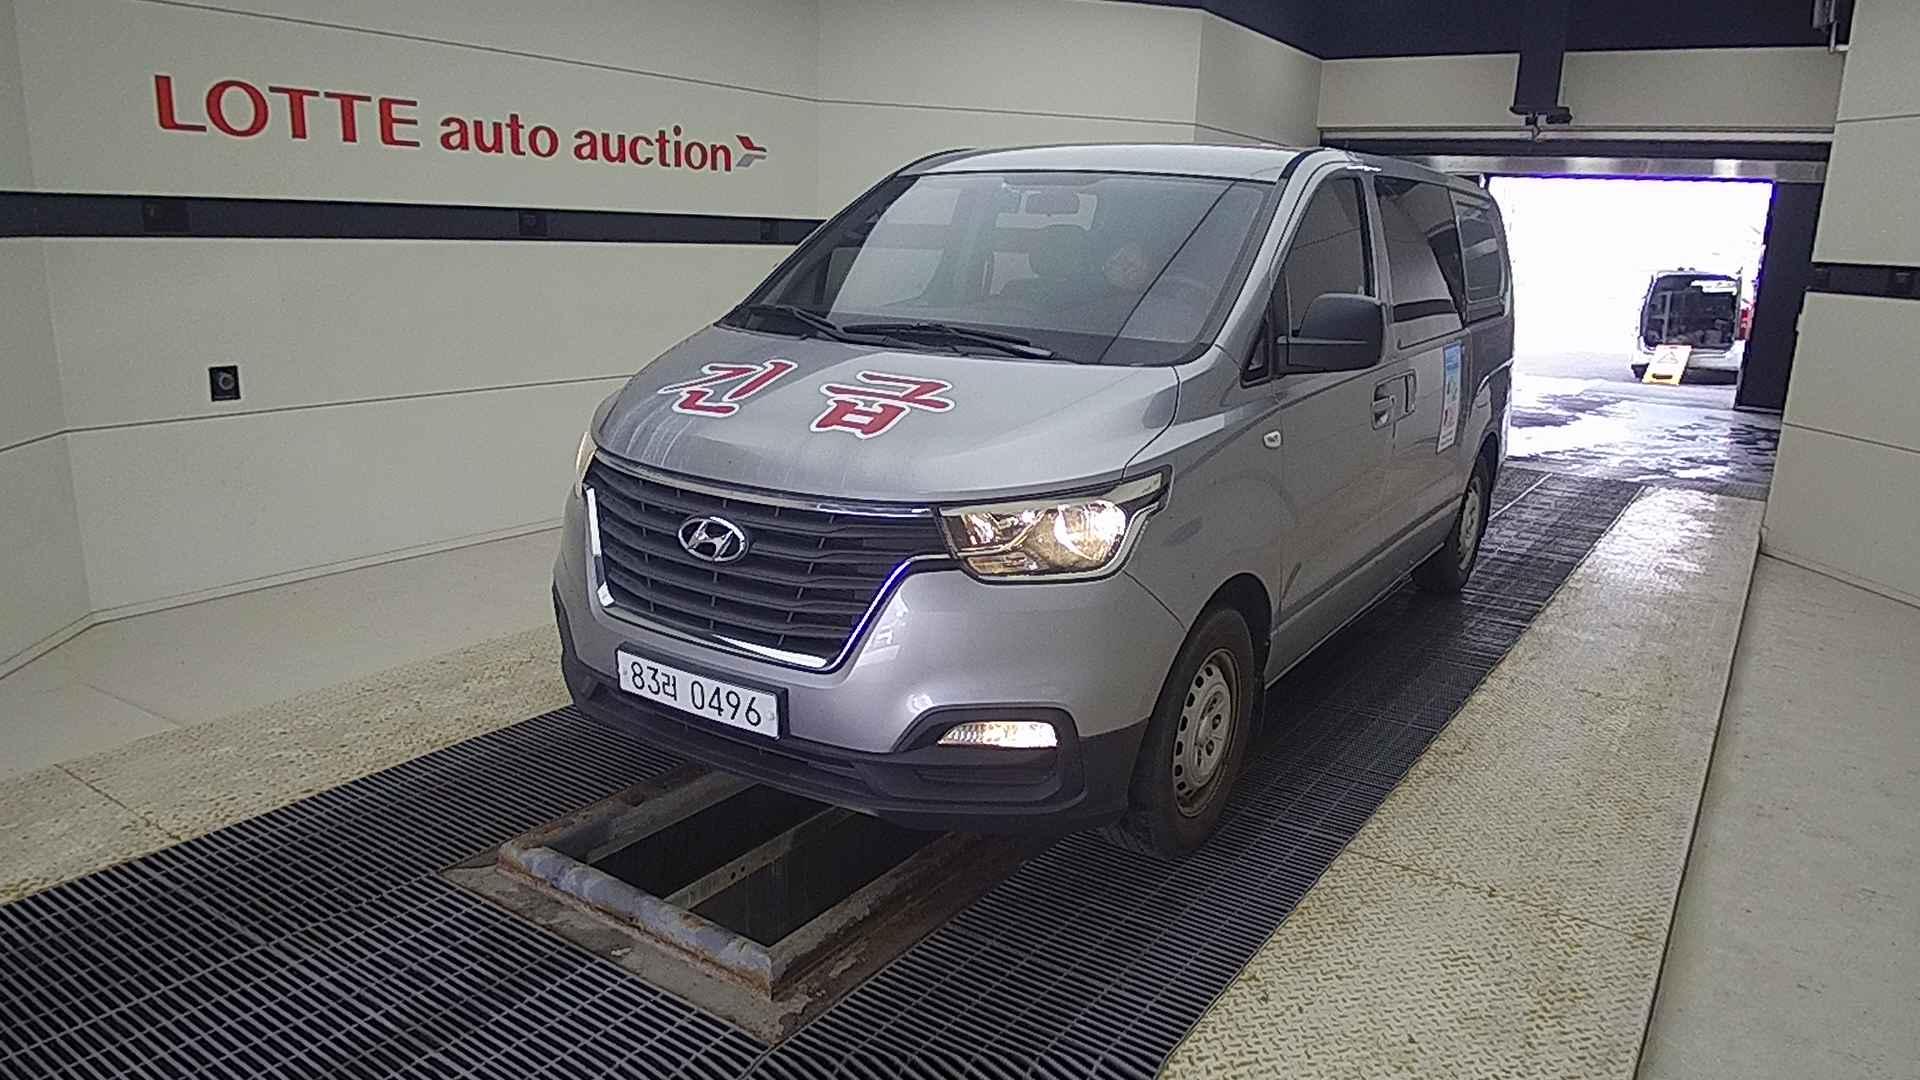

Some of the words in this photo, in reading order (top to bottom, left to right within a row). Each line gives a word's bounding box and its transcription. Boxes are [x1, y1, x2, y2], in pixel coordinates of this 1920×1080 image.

[154, 75, 420, 147] LOTTE
[440, 113, 559, 157] auto
[573, 125, 733, 172] auction
[630, 661, 677, 701] 83러
[691, 681, 761, 726] 0496
